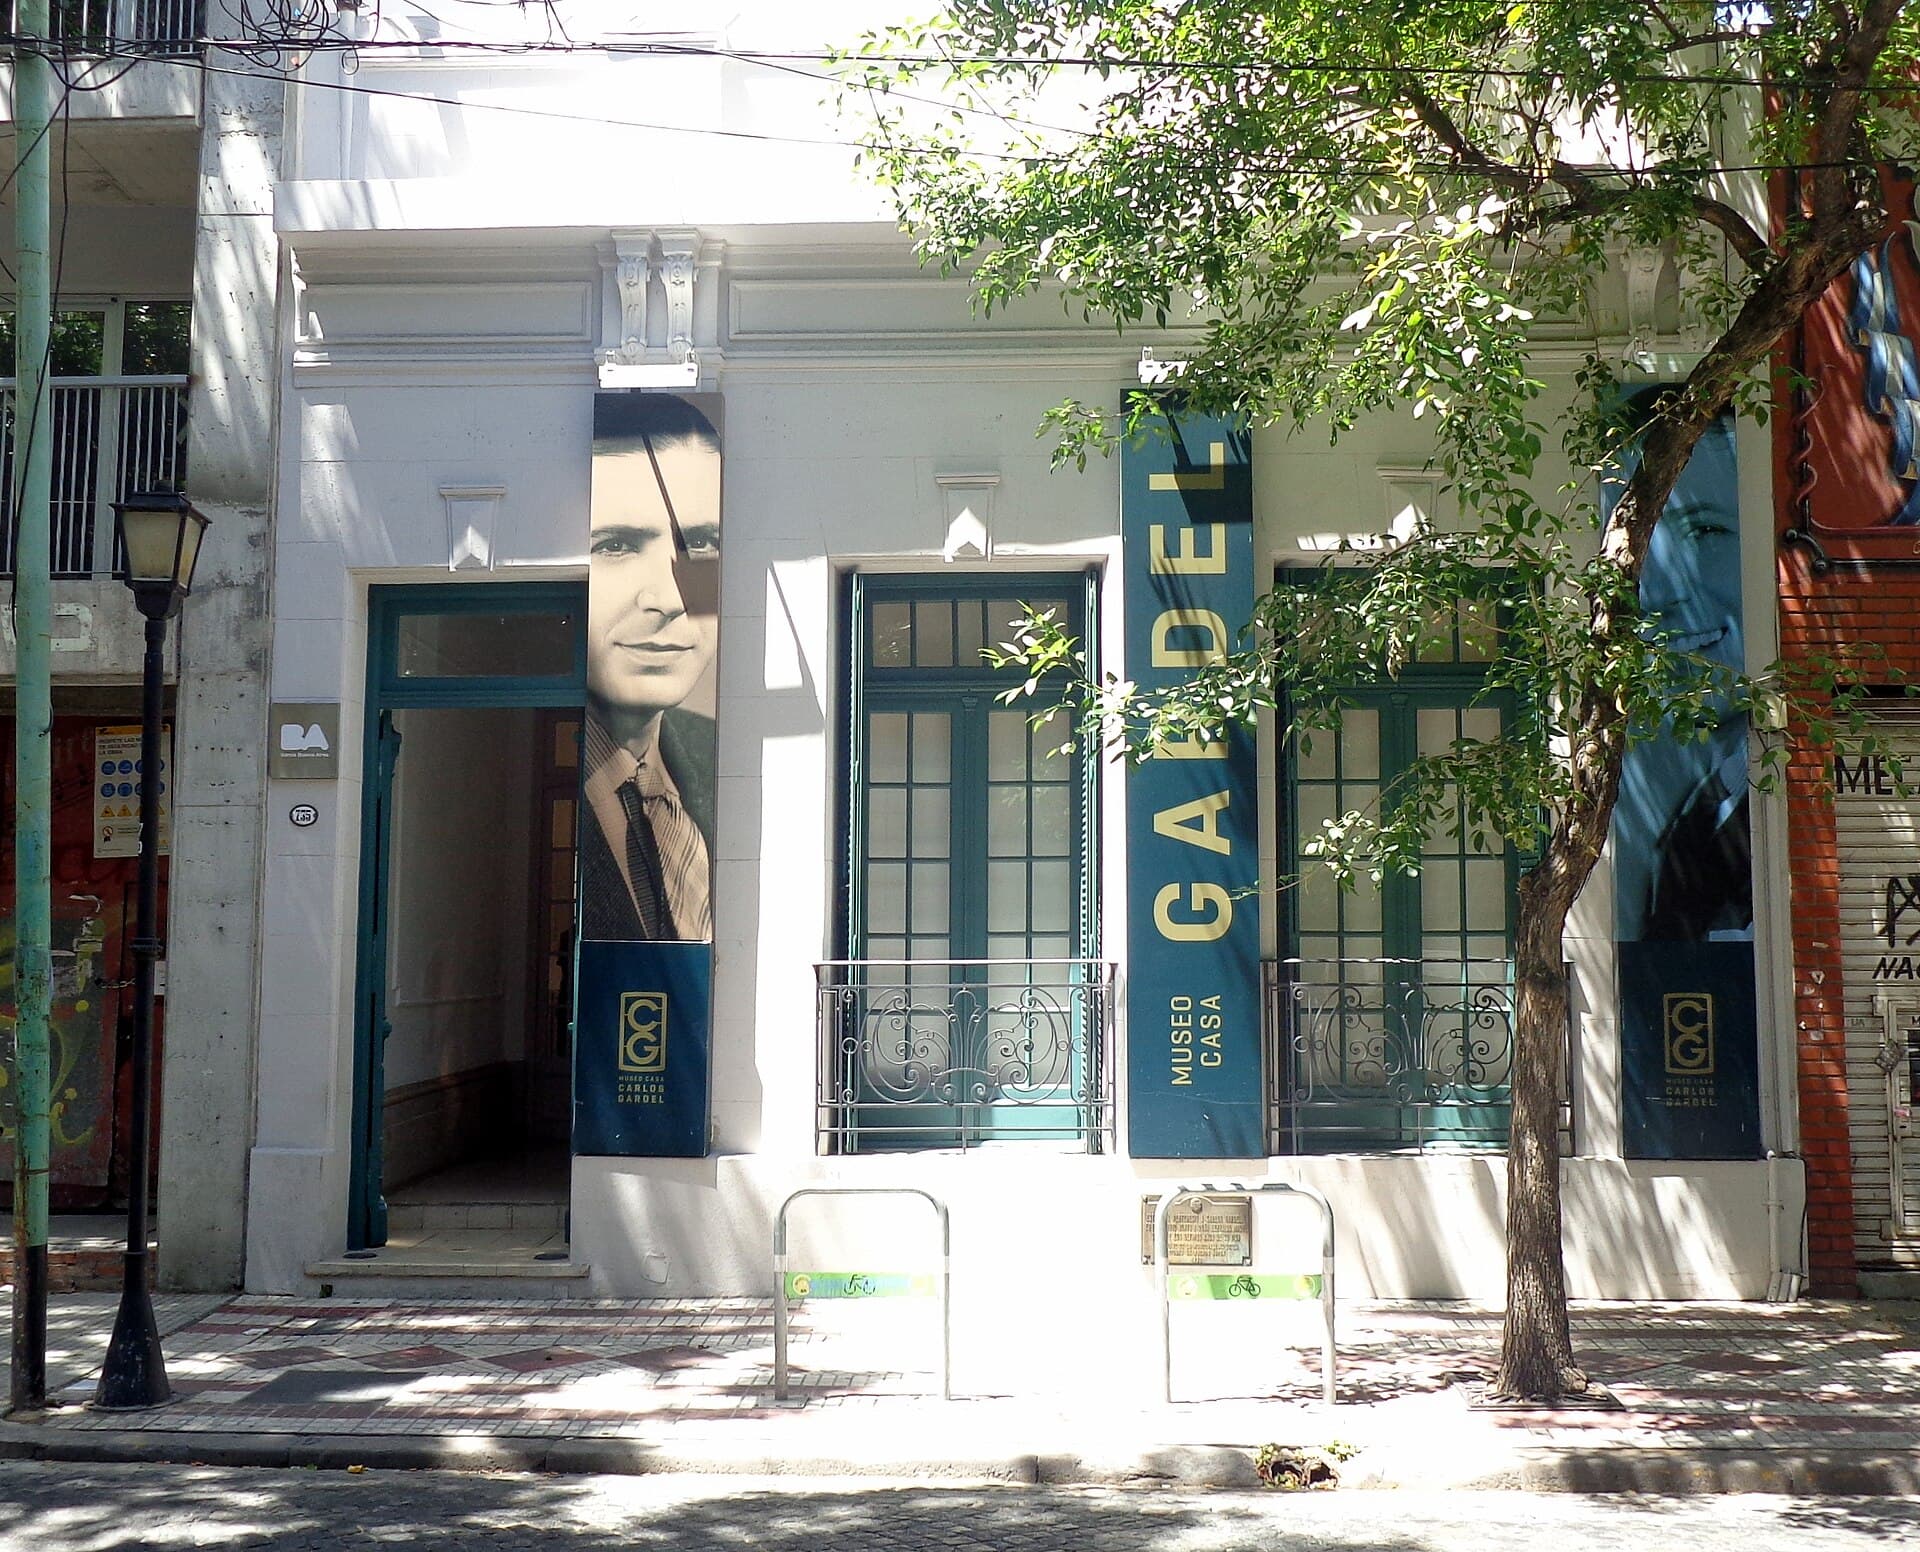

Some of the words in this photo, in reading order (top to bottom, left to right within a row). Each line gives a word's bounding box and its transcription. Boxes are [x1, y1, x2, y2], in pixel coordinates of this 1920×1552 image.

[281, 723, 329, 750] BA
[1872, 957, 1920, 980] NA
[1170, 994, 1193, 1086] MUSEO
[1200, 994, 1223, 1067] CASA
[618, 1083, 665, 1093] CARLOS
[618, 1094, 664, 1104] GARDEL
